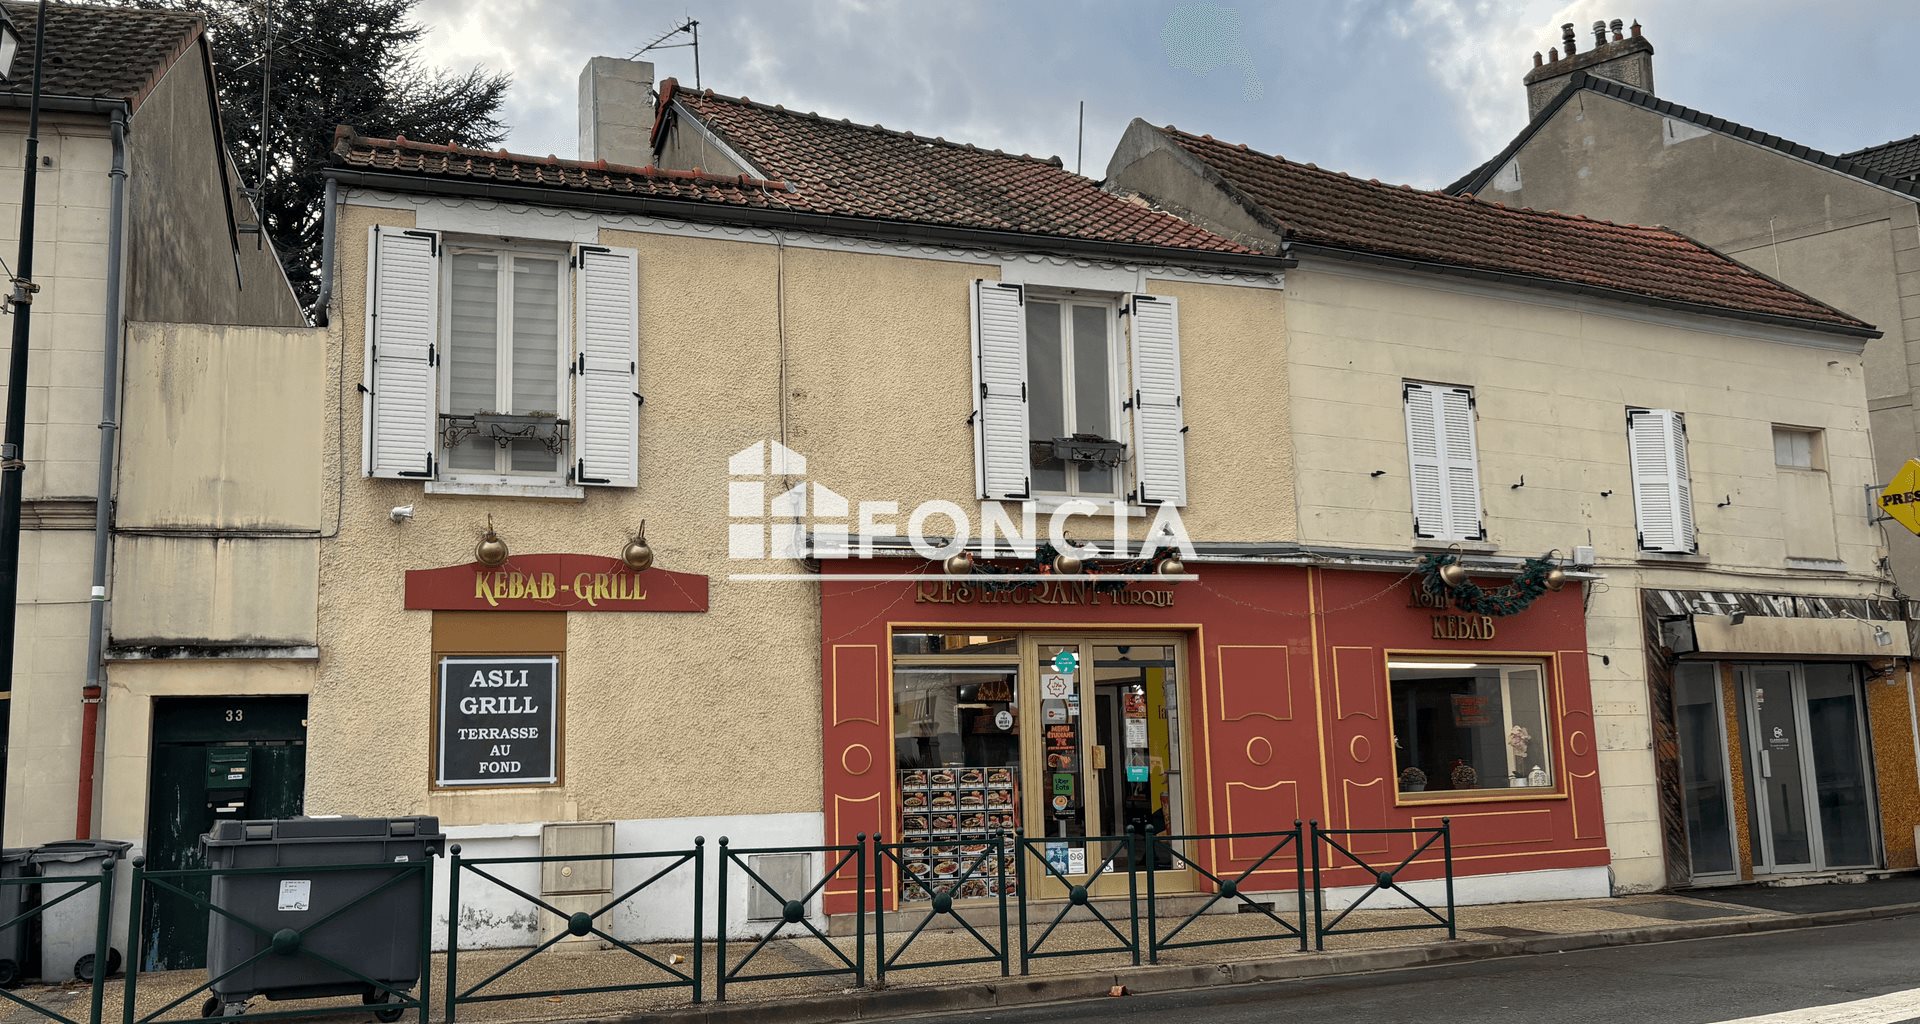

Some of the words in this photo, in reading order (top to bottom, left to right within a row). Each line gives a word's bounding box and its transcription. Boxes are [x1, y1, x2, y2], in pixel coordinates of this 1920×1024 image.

[474, 570, 556, 607] KEBAB
[574, 573, 647, 607] GRILL
[1111, 589, 1174, 607] TURQUE
[1431, 614, 1496, 640] KEBAB
[470, 670, 528, 687] ASLI
[459, 696, 538, 715] GRILL
[225, 709, 243, 722] 33
[458, 727, 539, 740] TERRASSE
[489, 744, 511, 757] AU
[479, 761, 521, 774] FOND
